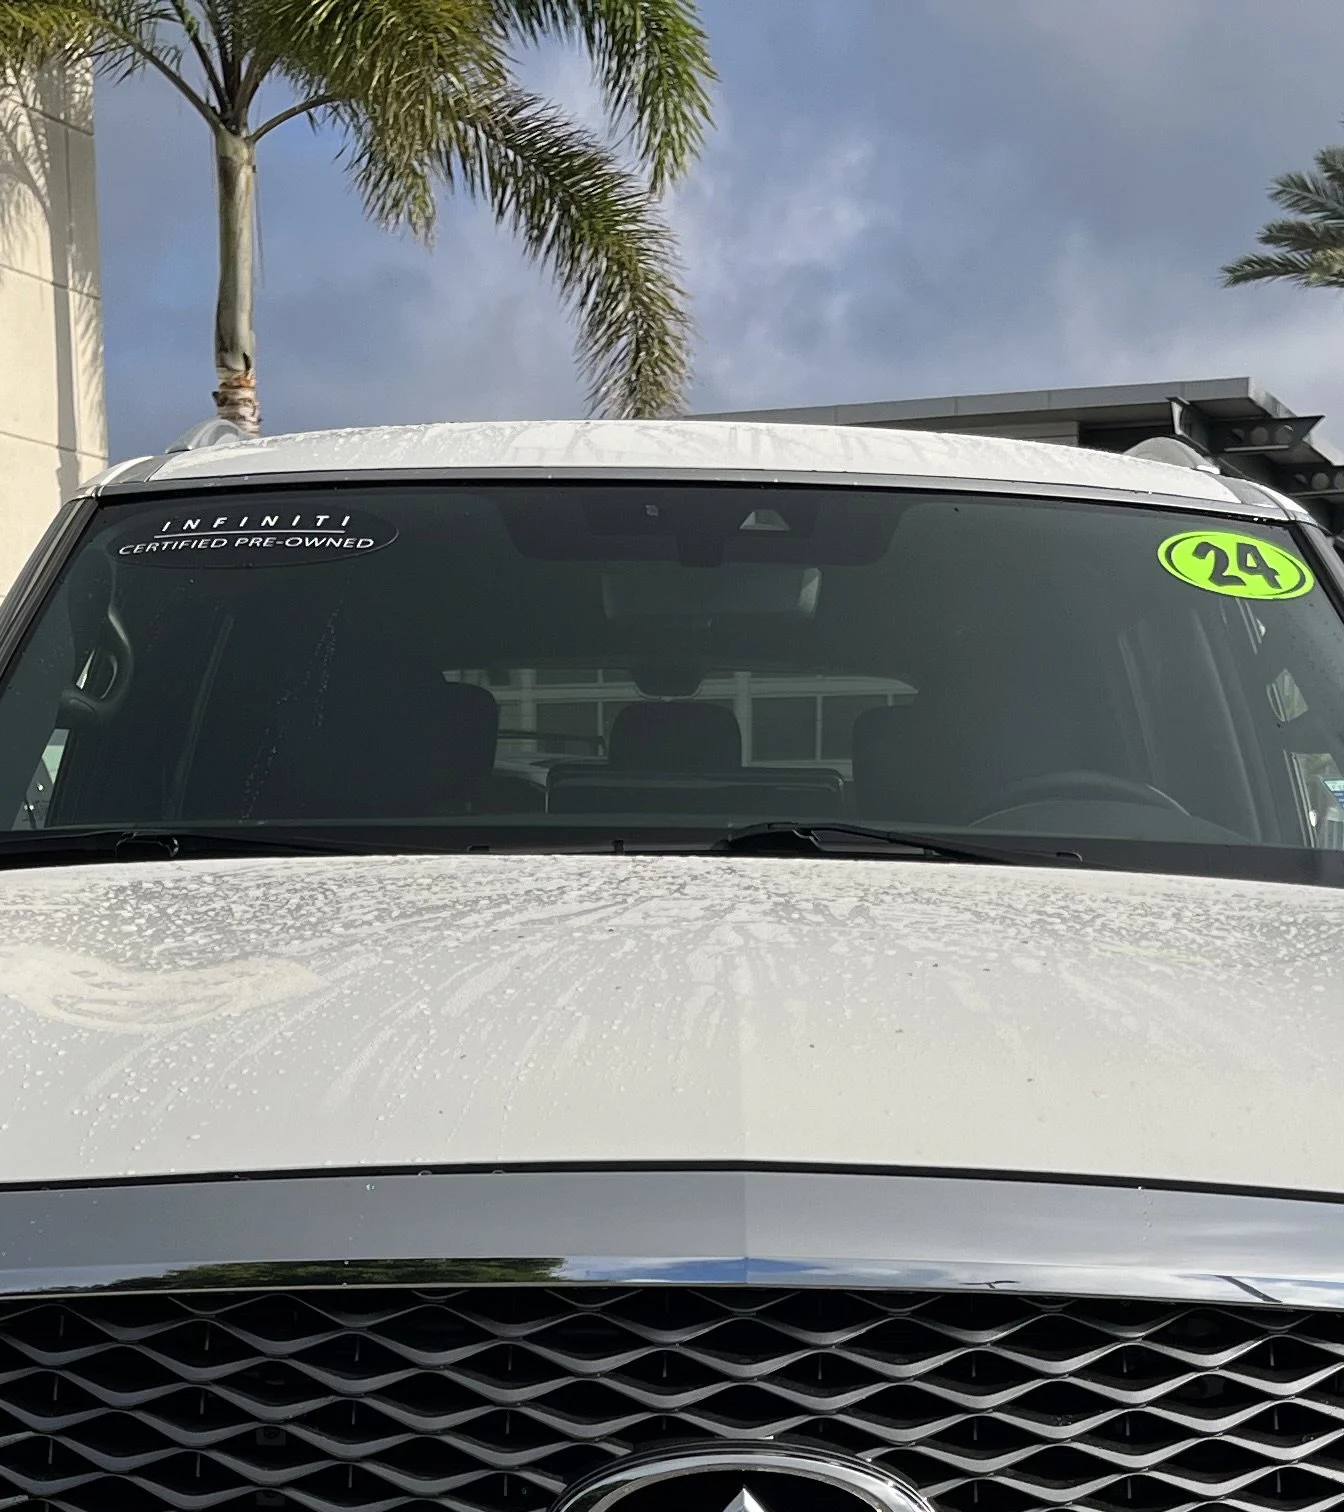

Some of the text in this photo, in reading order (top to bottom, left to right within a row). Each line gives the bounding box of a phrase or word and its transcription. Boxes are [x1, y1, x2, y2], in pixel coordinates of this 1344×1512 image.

[161, 514, 352, 532] INFINITI
[118, 536, 375, 556] CERTIFIED PRE-OWNED
[1191, 540, 1284, 590] 24
